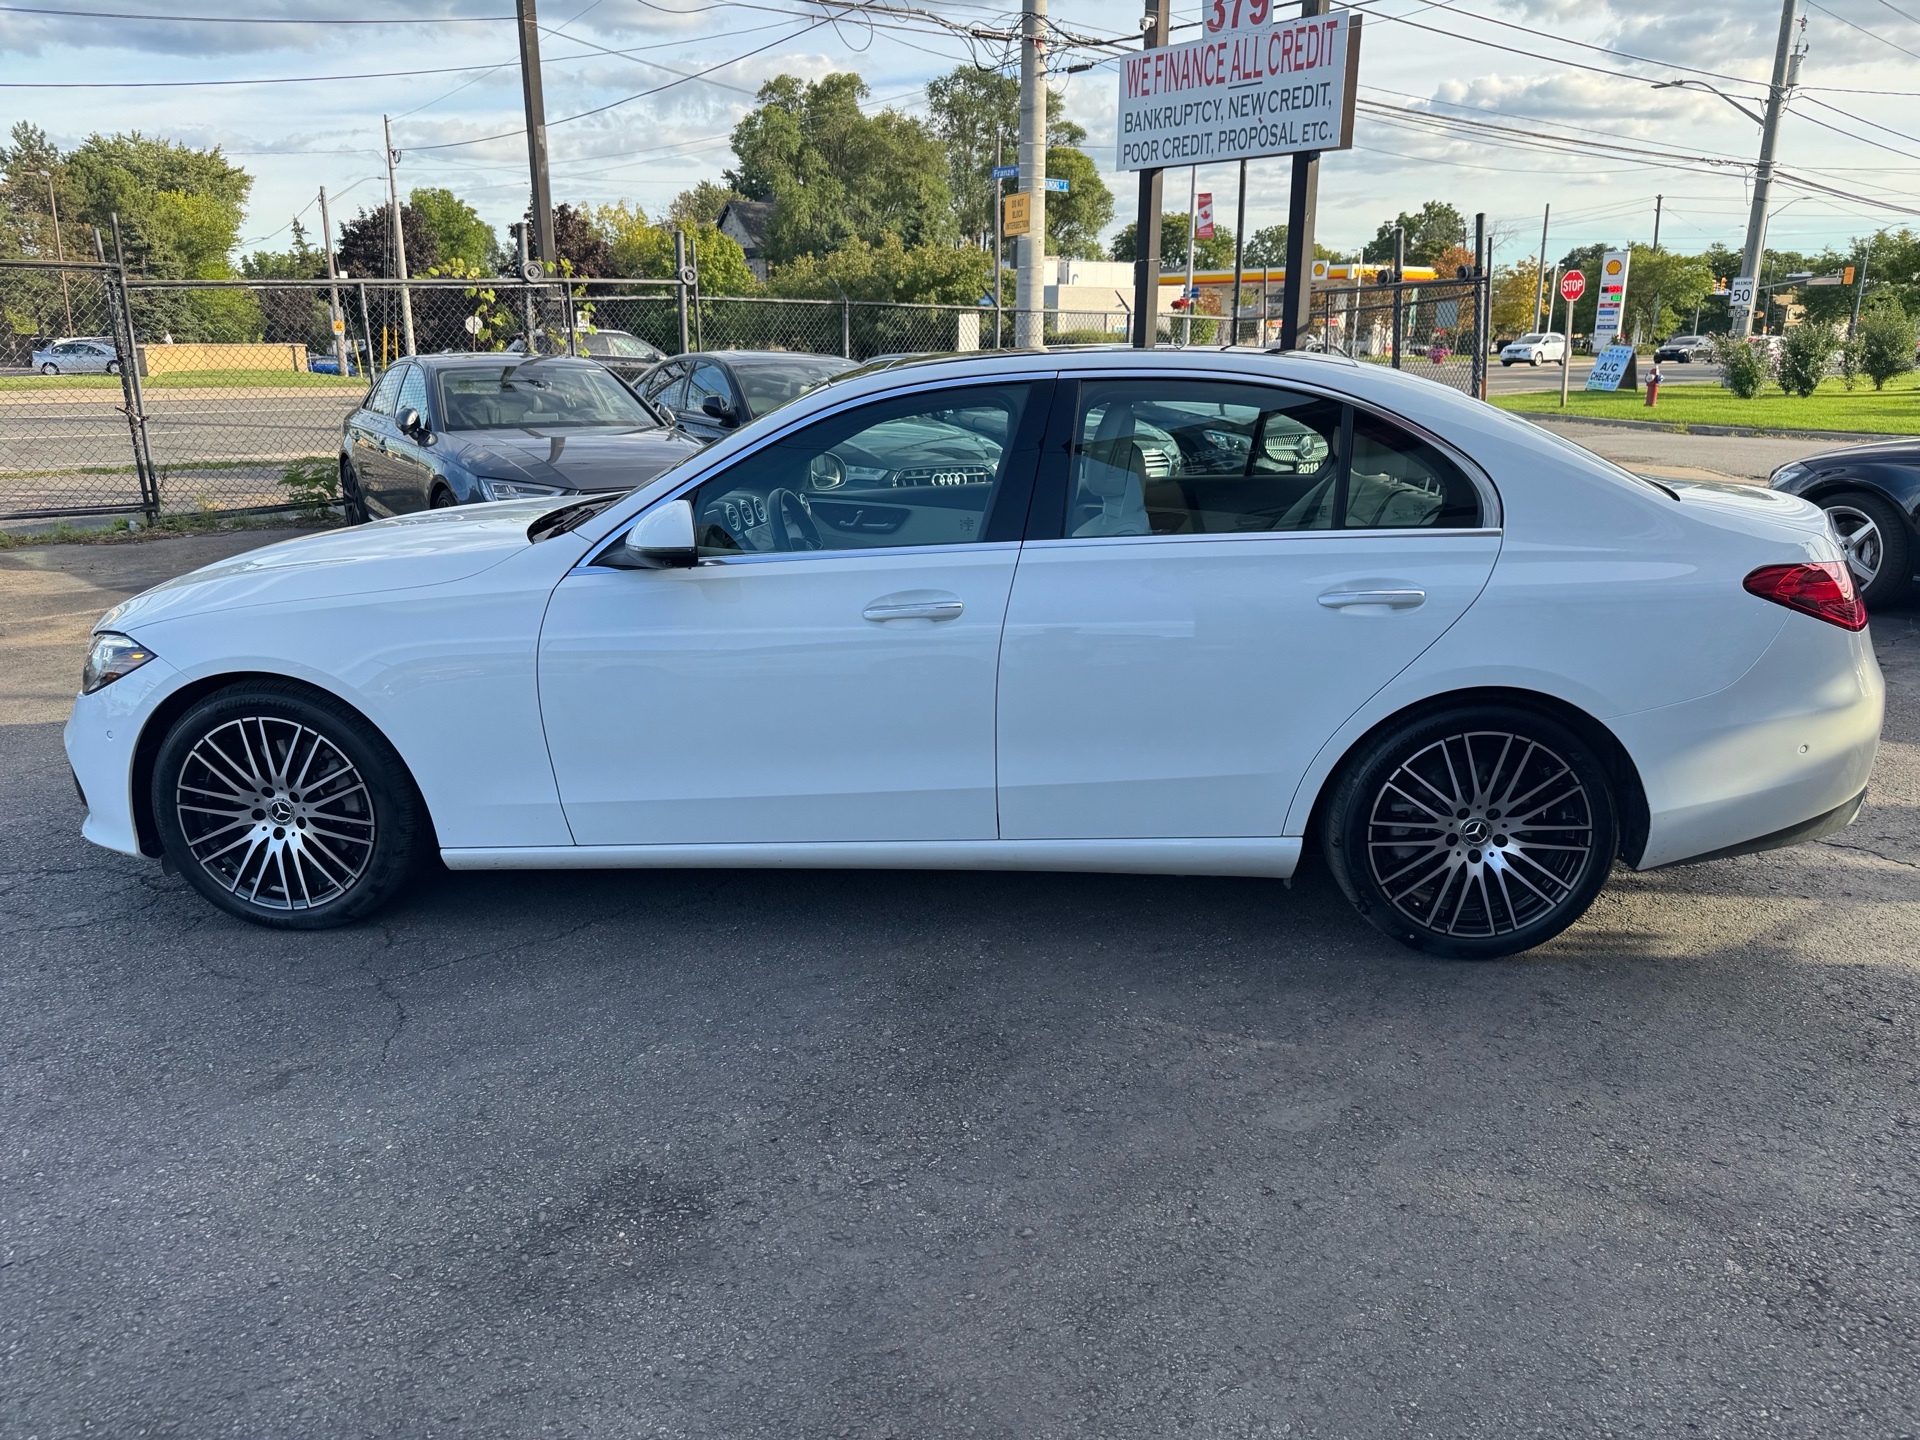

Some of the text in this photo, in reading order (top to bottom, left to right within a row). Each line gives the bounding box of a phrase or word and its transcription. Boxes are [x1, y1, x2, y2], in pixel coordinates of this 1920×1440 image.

[1126, 20, 1338, 98] WE FINANCE ALL CREDIT
[1124, 81, 1332, 134] BANKRUPTCY, NEW CREDIT,
[1123, 121, 1333, 164] POOR CREDIT, PROPOSAL ETC.
[993, 169, 1015, 178] Franze
[1011, 200, 1017, 208] DO
[1012, 210, 1024, 219] BLOCK
[1563, 279, 1583, 292] STOP
[1732, 289, 1751, 302] 50
[1600, 362, 1619, 372] A/C
[1590, 371, 1621, 383] CHECK-UP
[1298, 463, 1319, 474] 2019
[215, 697, 306, 715] BRIDGESTONE
